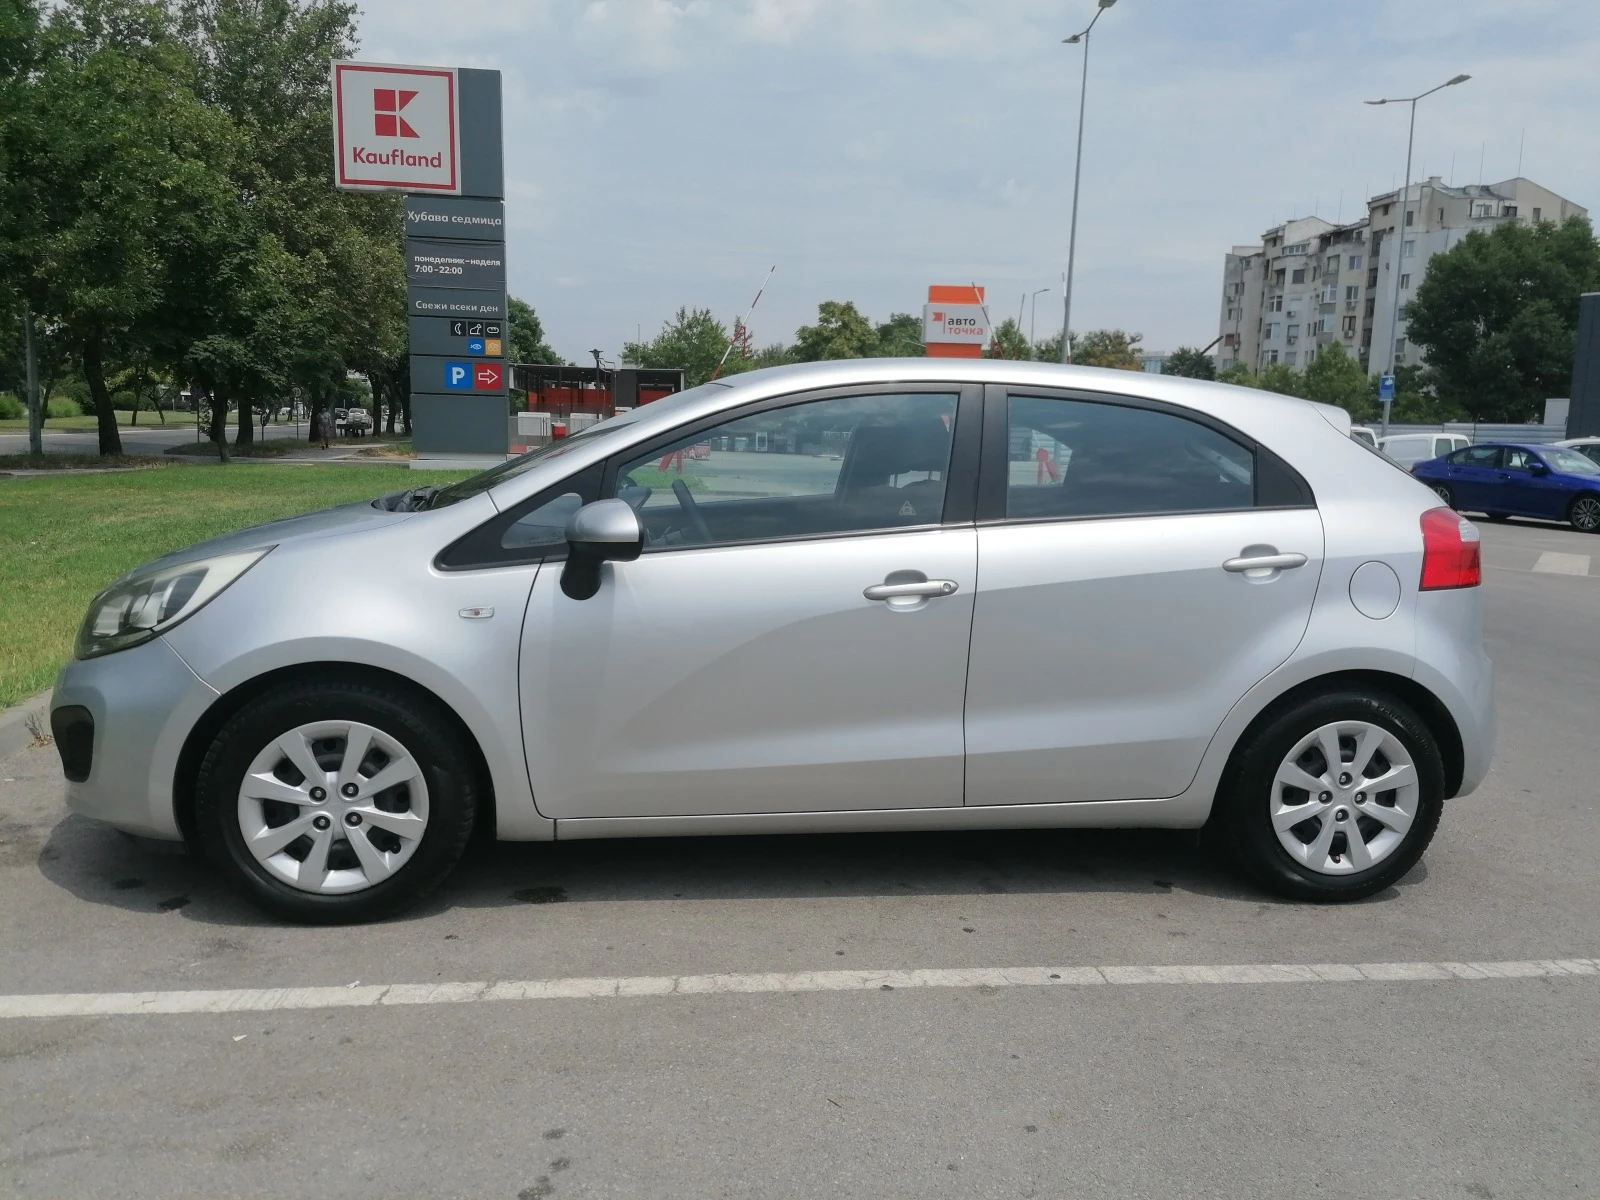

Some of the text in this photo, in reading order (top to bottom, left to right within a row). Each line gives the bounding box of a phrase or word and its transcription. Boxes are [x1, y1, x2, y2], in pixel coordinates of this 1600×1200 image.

[352, 146, 442, 169] Kaufland
[407, 210, 502, 226] Хубава седмица
[415, 300, 499, 313] Свежи всеки ден
[947, 318, 976, 326] авто
[947, 327, 984, 336] точка
[451, 366, 466, 385] P
